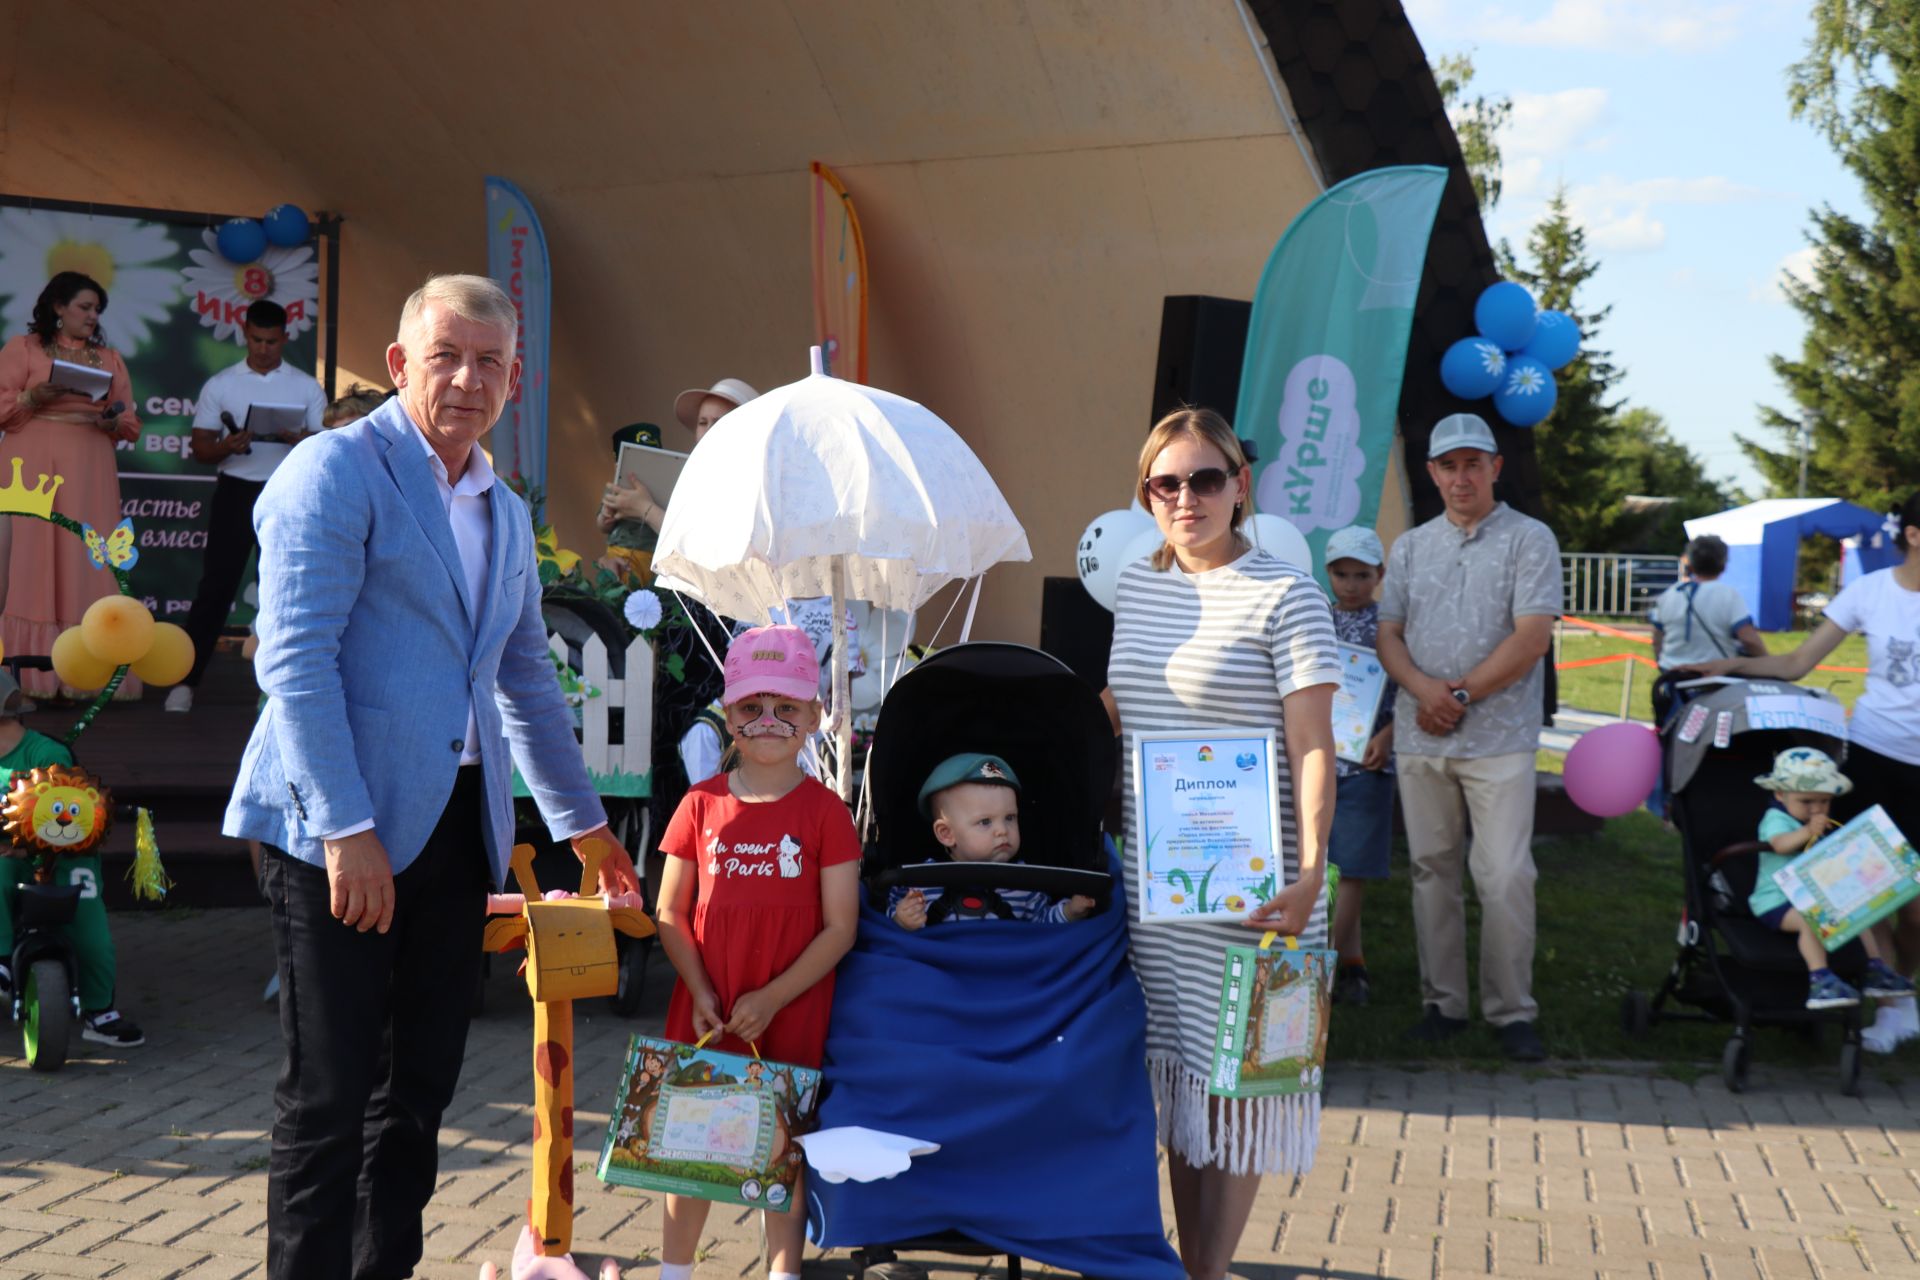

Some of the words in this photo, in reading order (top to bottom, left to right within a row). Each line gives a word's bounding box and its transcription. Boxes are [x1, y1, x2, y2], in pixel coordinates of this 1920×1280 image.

[244, 267, 269, 296] 8
[145, 395, 198, 417] сем
[119, 498, 202, 519] астье
[140, 529, 209, 549] вмес
[1174, 778, 1237, 792] Диплом
[706, 836, 728, 856] Au
[707, 856, 722, 876] de
[724, 857, 774, 878] Paris
